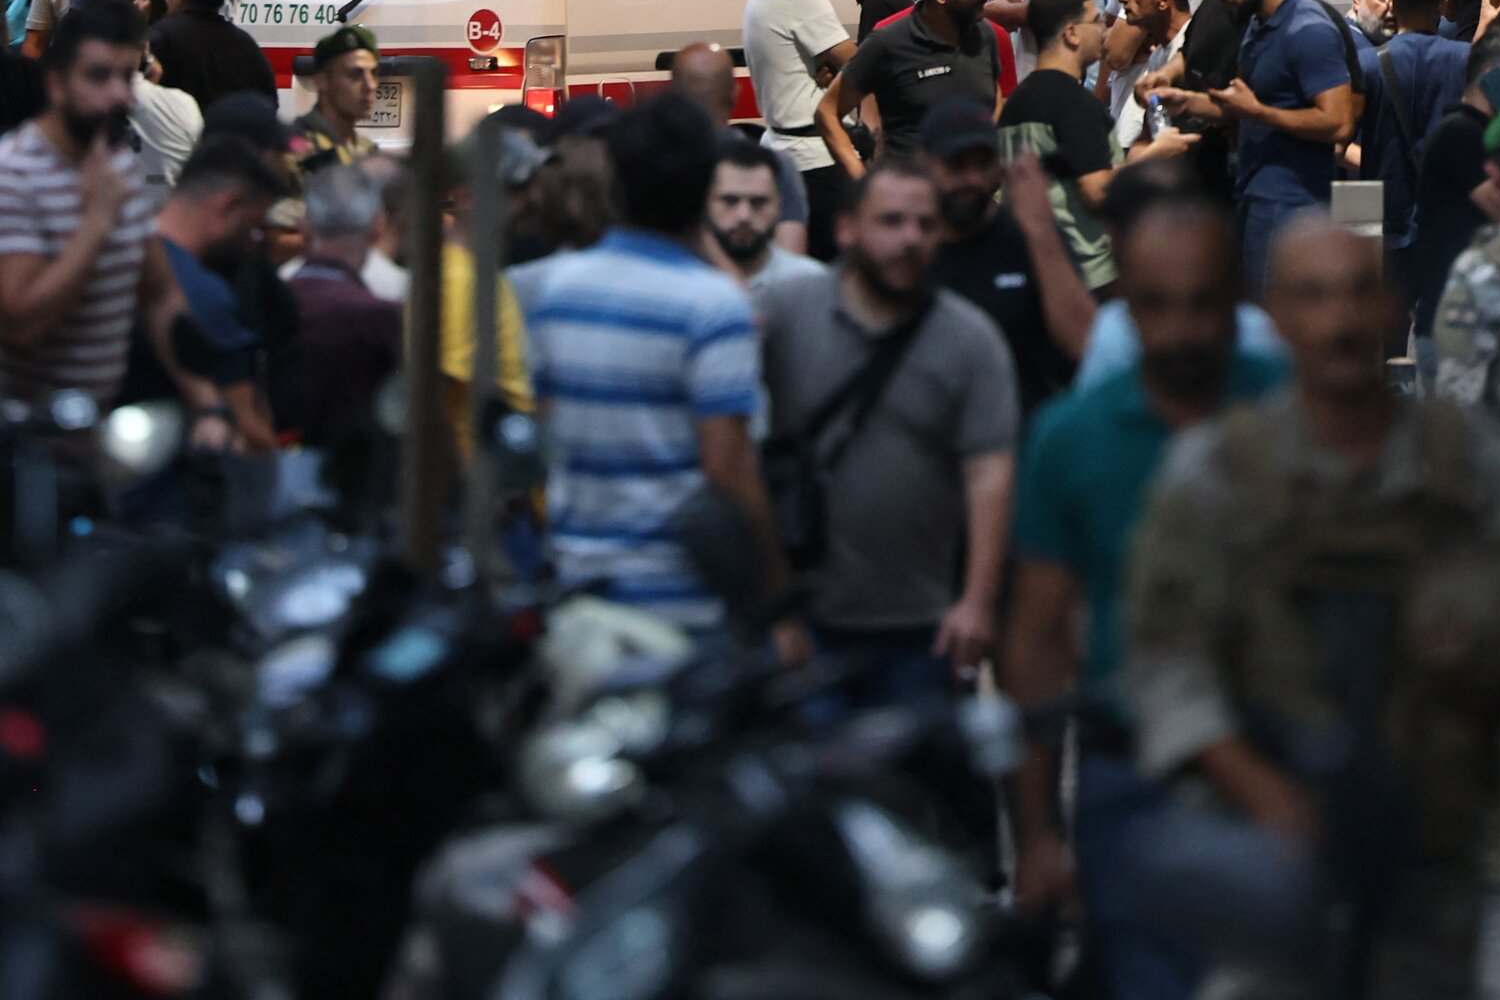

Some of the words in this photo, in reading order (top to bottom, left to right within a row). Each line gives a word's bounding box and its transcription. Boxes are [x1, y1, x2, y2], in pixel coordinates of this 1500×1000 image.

[240, 3, 258, 24] 70
[264, 3, 283, 24] 76
[289, 3, 309, 24] 76
[470, 21, 500, 40] B-4
